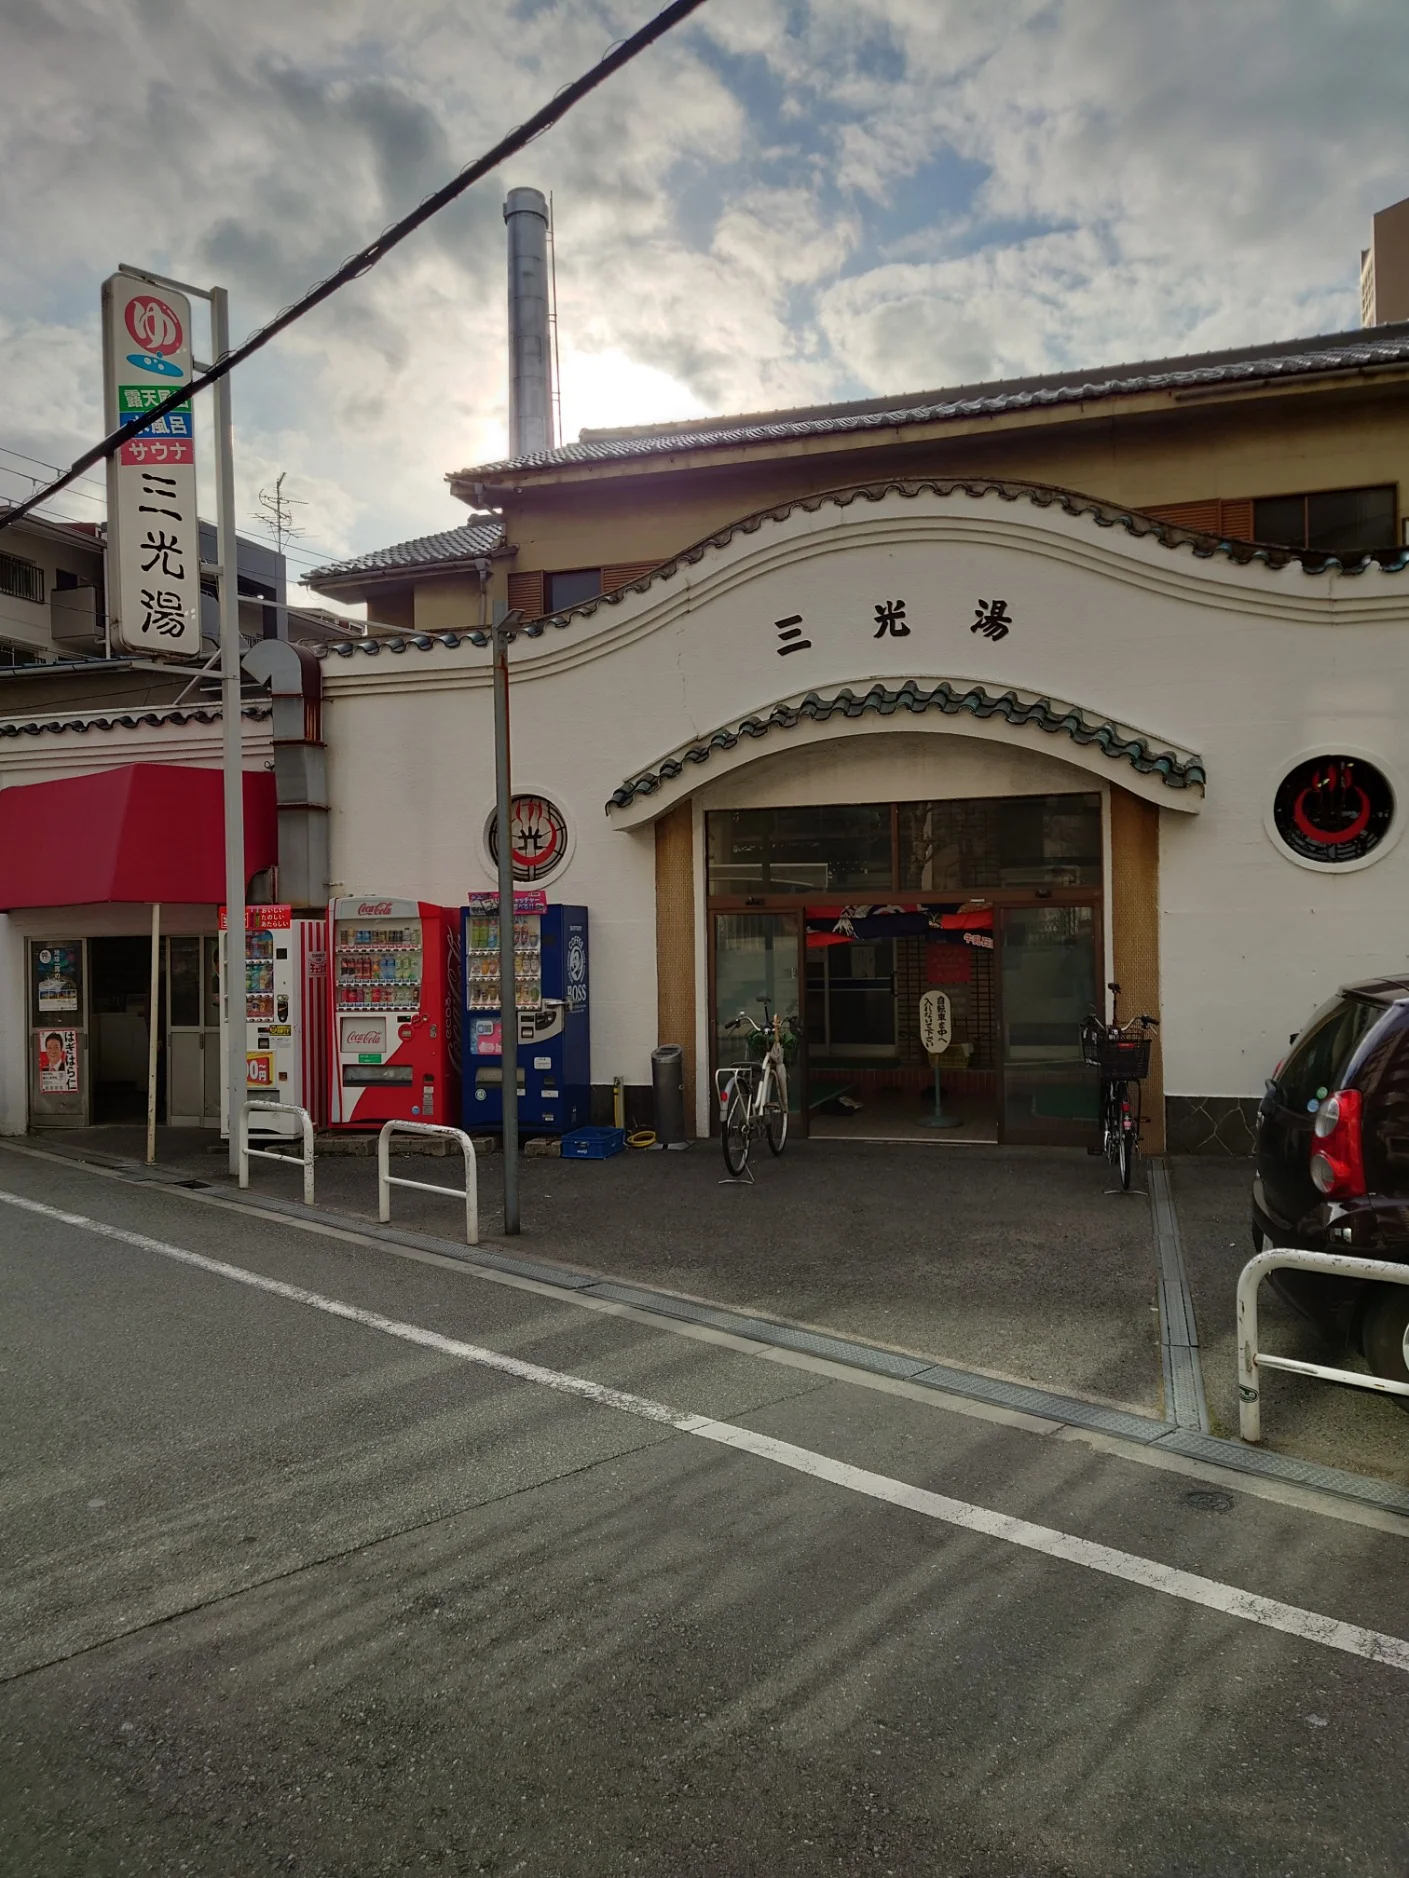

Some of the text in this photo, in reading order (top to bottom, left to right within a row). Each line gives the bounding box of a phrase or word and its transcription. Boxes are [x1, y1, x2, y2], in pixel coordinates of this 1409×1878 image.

[133, 301, 177, 349] ゆ
[128, 442, 187, 461] サウナ
[138, 473, 185, 638] 三光湯
[774, 599, 1013, 656] 三光湯
[357, 901, 394, 916] Coca-Cola
[64, 1031, 77, 1090] はぎはら仁
[346, 1030, 383, 1044] Coca-Cola
